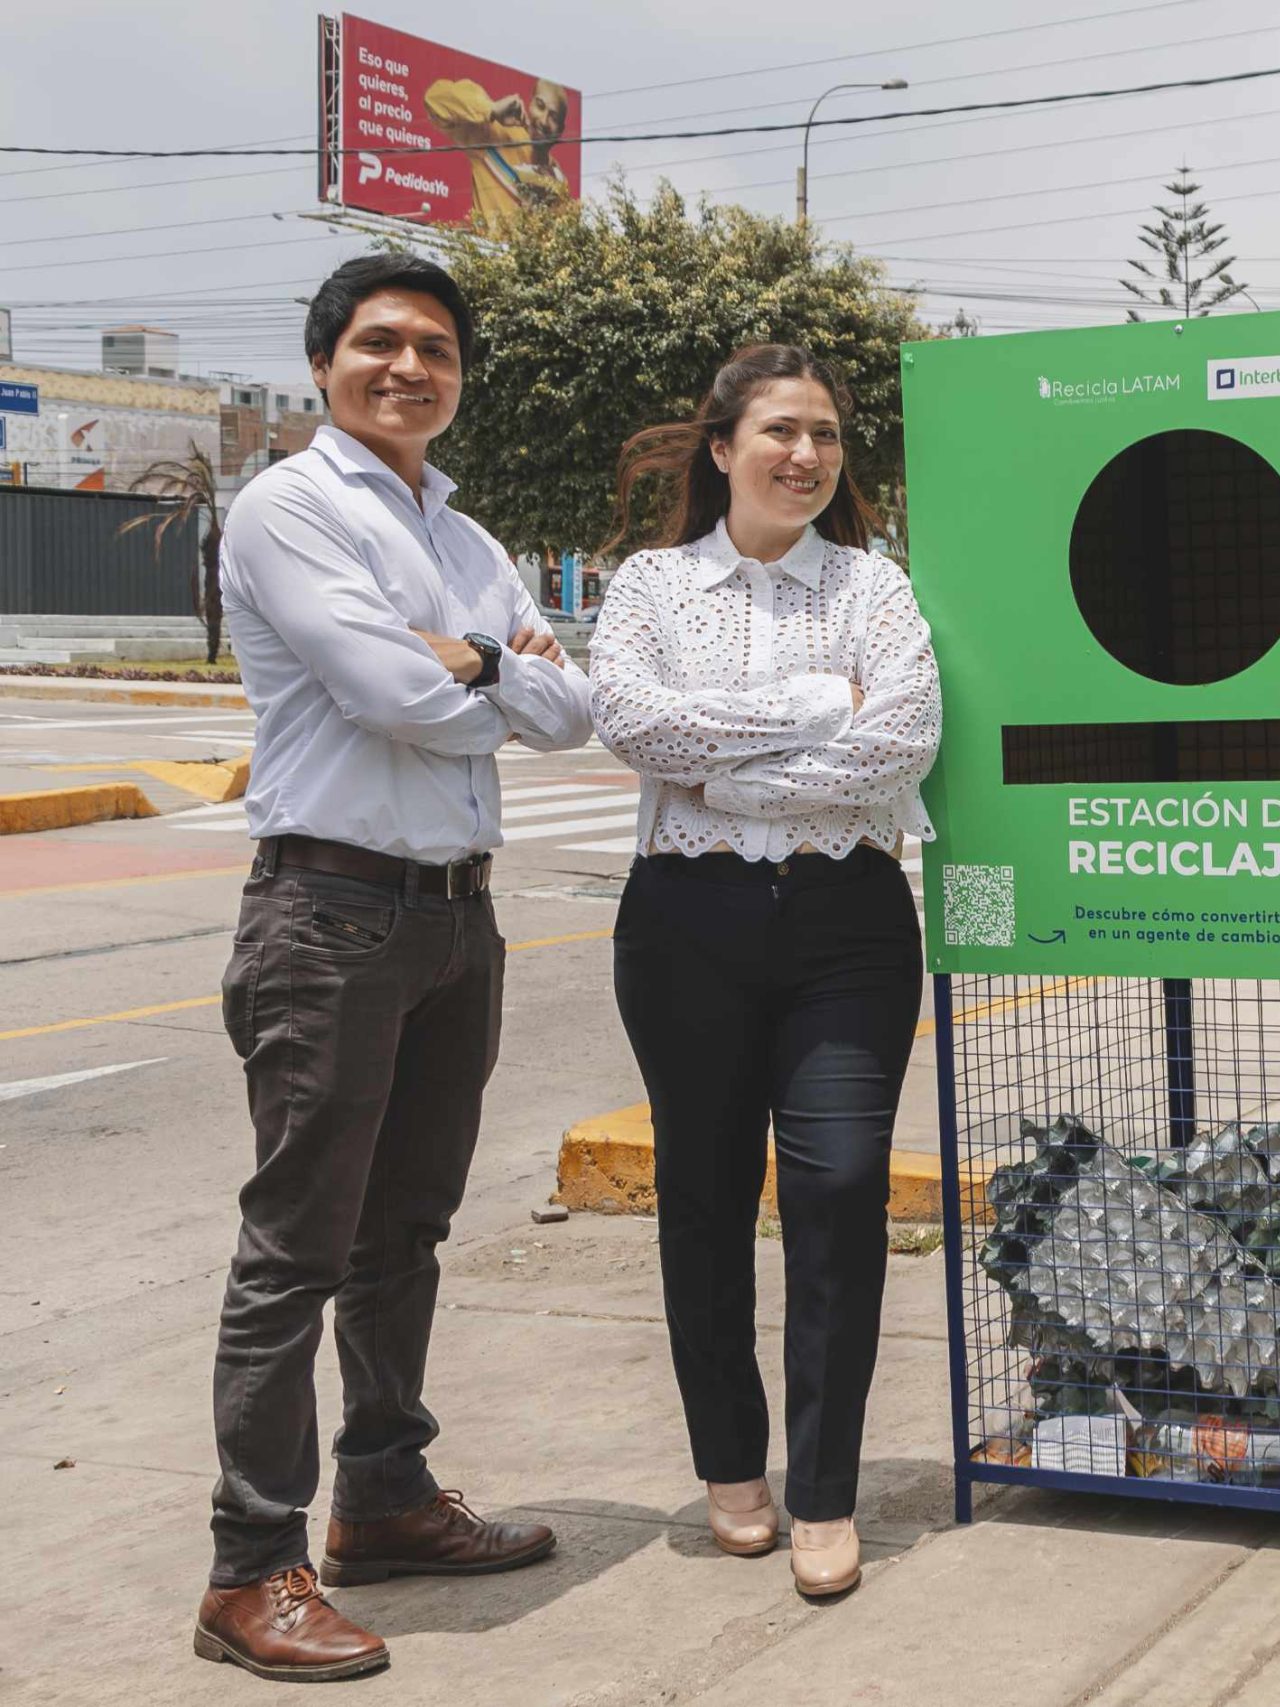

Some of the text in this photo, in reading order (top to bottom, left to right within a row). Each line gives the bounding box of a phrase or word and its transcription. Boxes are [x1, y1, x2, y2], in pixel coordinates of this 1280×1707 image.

[359, 46, 409, 77] Eso que
[359, 73, 409, 101] quieres,
[359, 94, 412, 122] al precio
[359, 119, 431, 149] que quieres
[385, 167, 449, 197] PedidosYa
[1052, 374, 1180, 397] Recicla LATAM
[1068, 791, 1248, 828] ESTACIÓN
[1075, 905, 1147, 921] Descubre
[1152, 908, 1196, 922] cómo
[1088, 928, 1106, 939] en
[1112, 929, 1131, 940] un
[1136, 929, 1191, 944] agente
[1196, 928, 1216, 942] de
